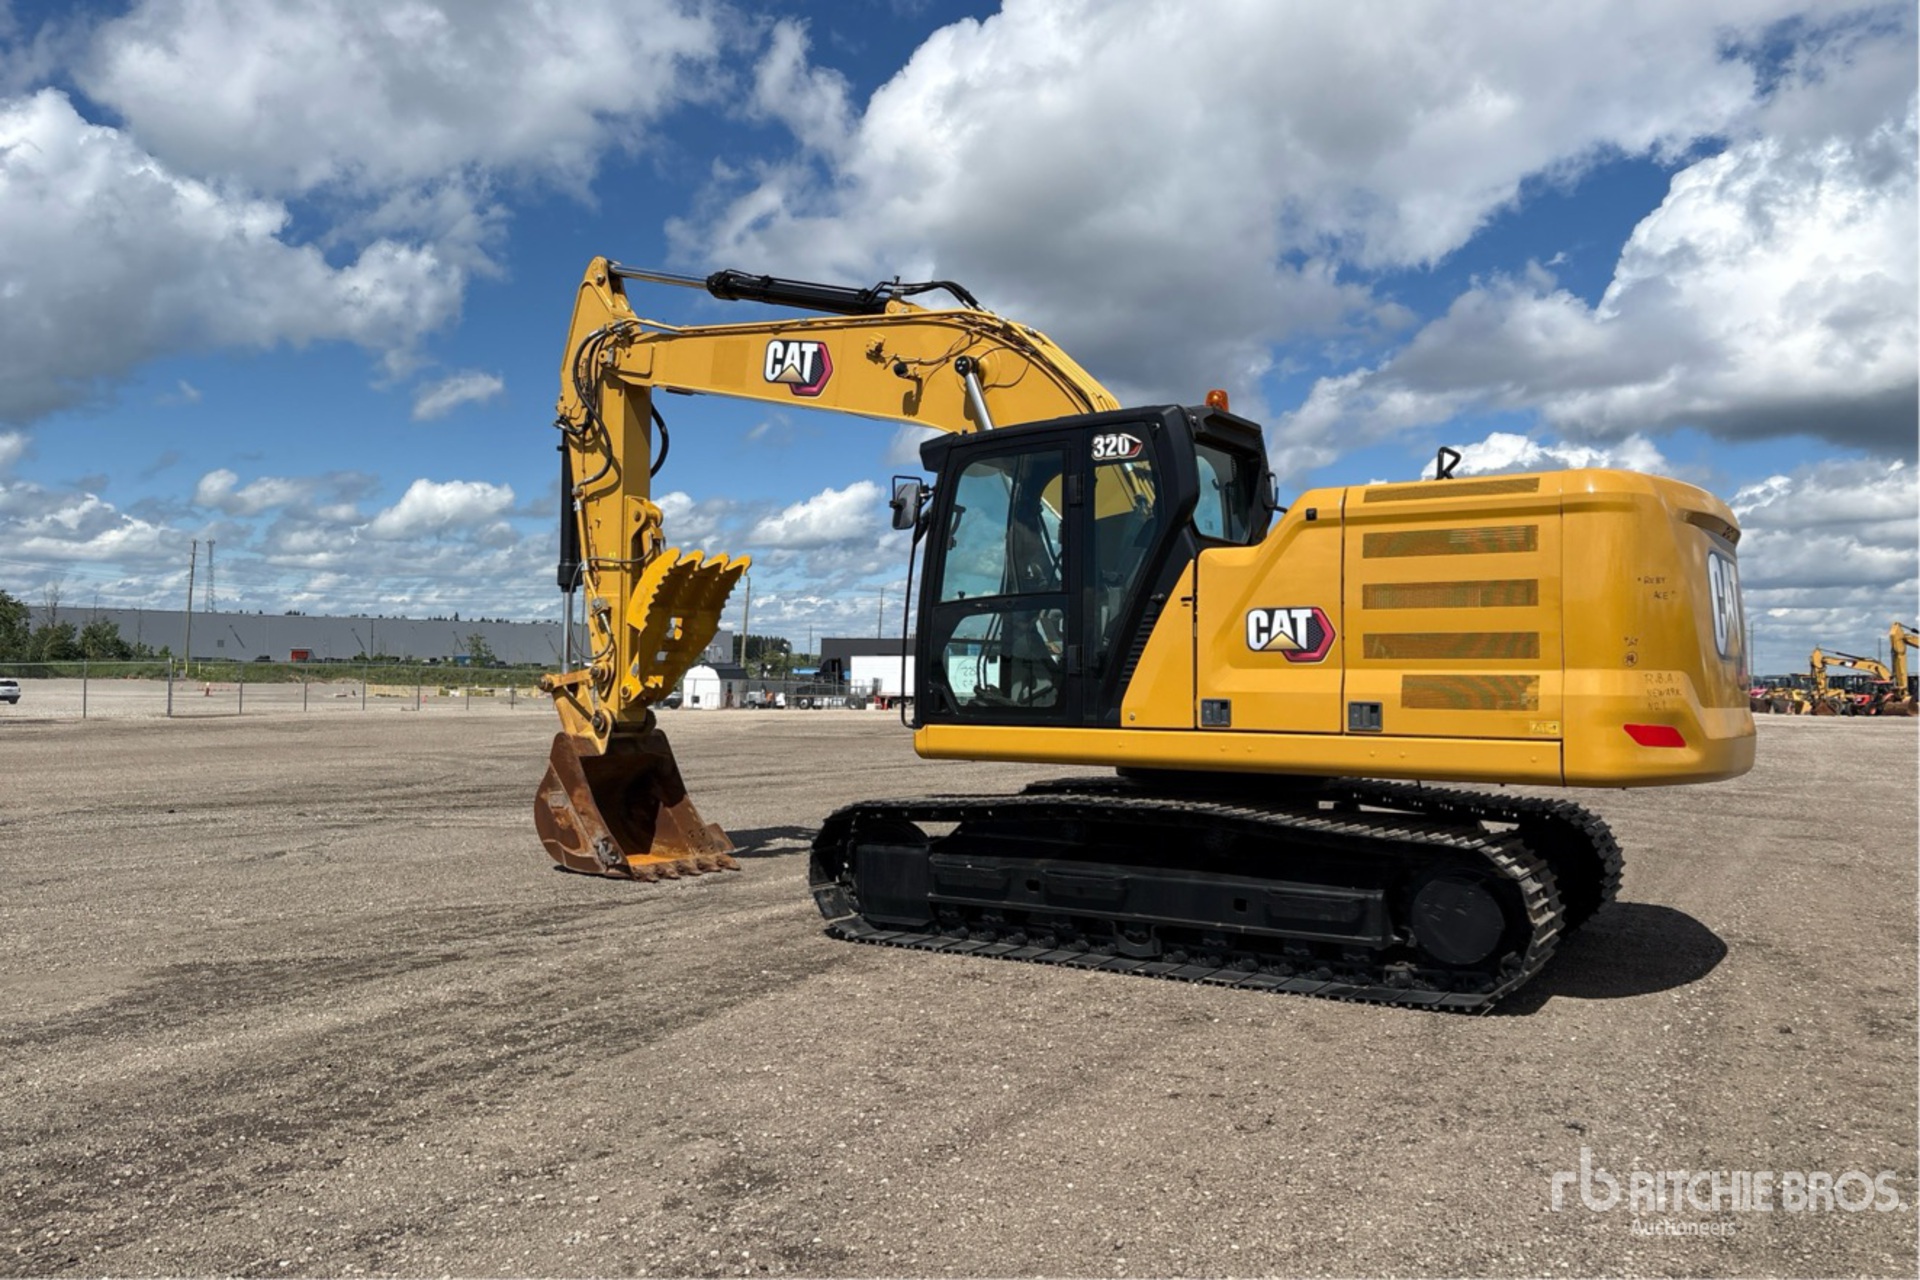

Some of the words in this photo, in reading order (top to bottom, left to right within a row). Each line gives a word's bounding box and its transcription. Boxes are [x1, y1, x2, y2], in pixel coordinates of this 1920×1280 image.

[765, 340, 819, 383] CAT
[1093, 436, 1130, 458] 320
[1708, 553, 1742, 655] CAT
[1247, 608, 1313, 651] CAT
